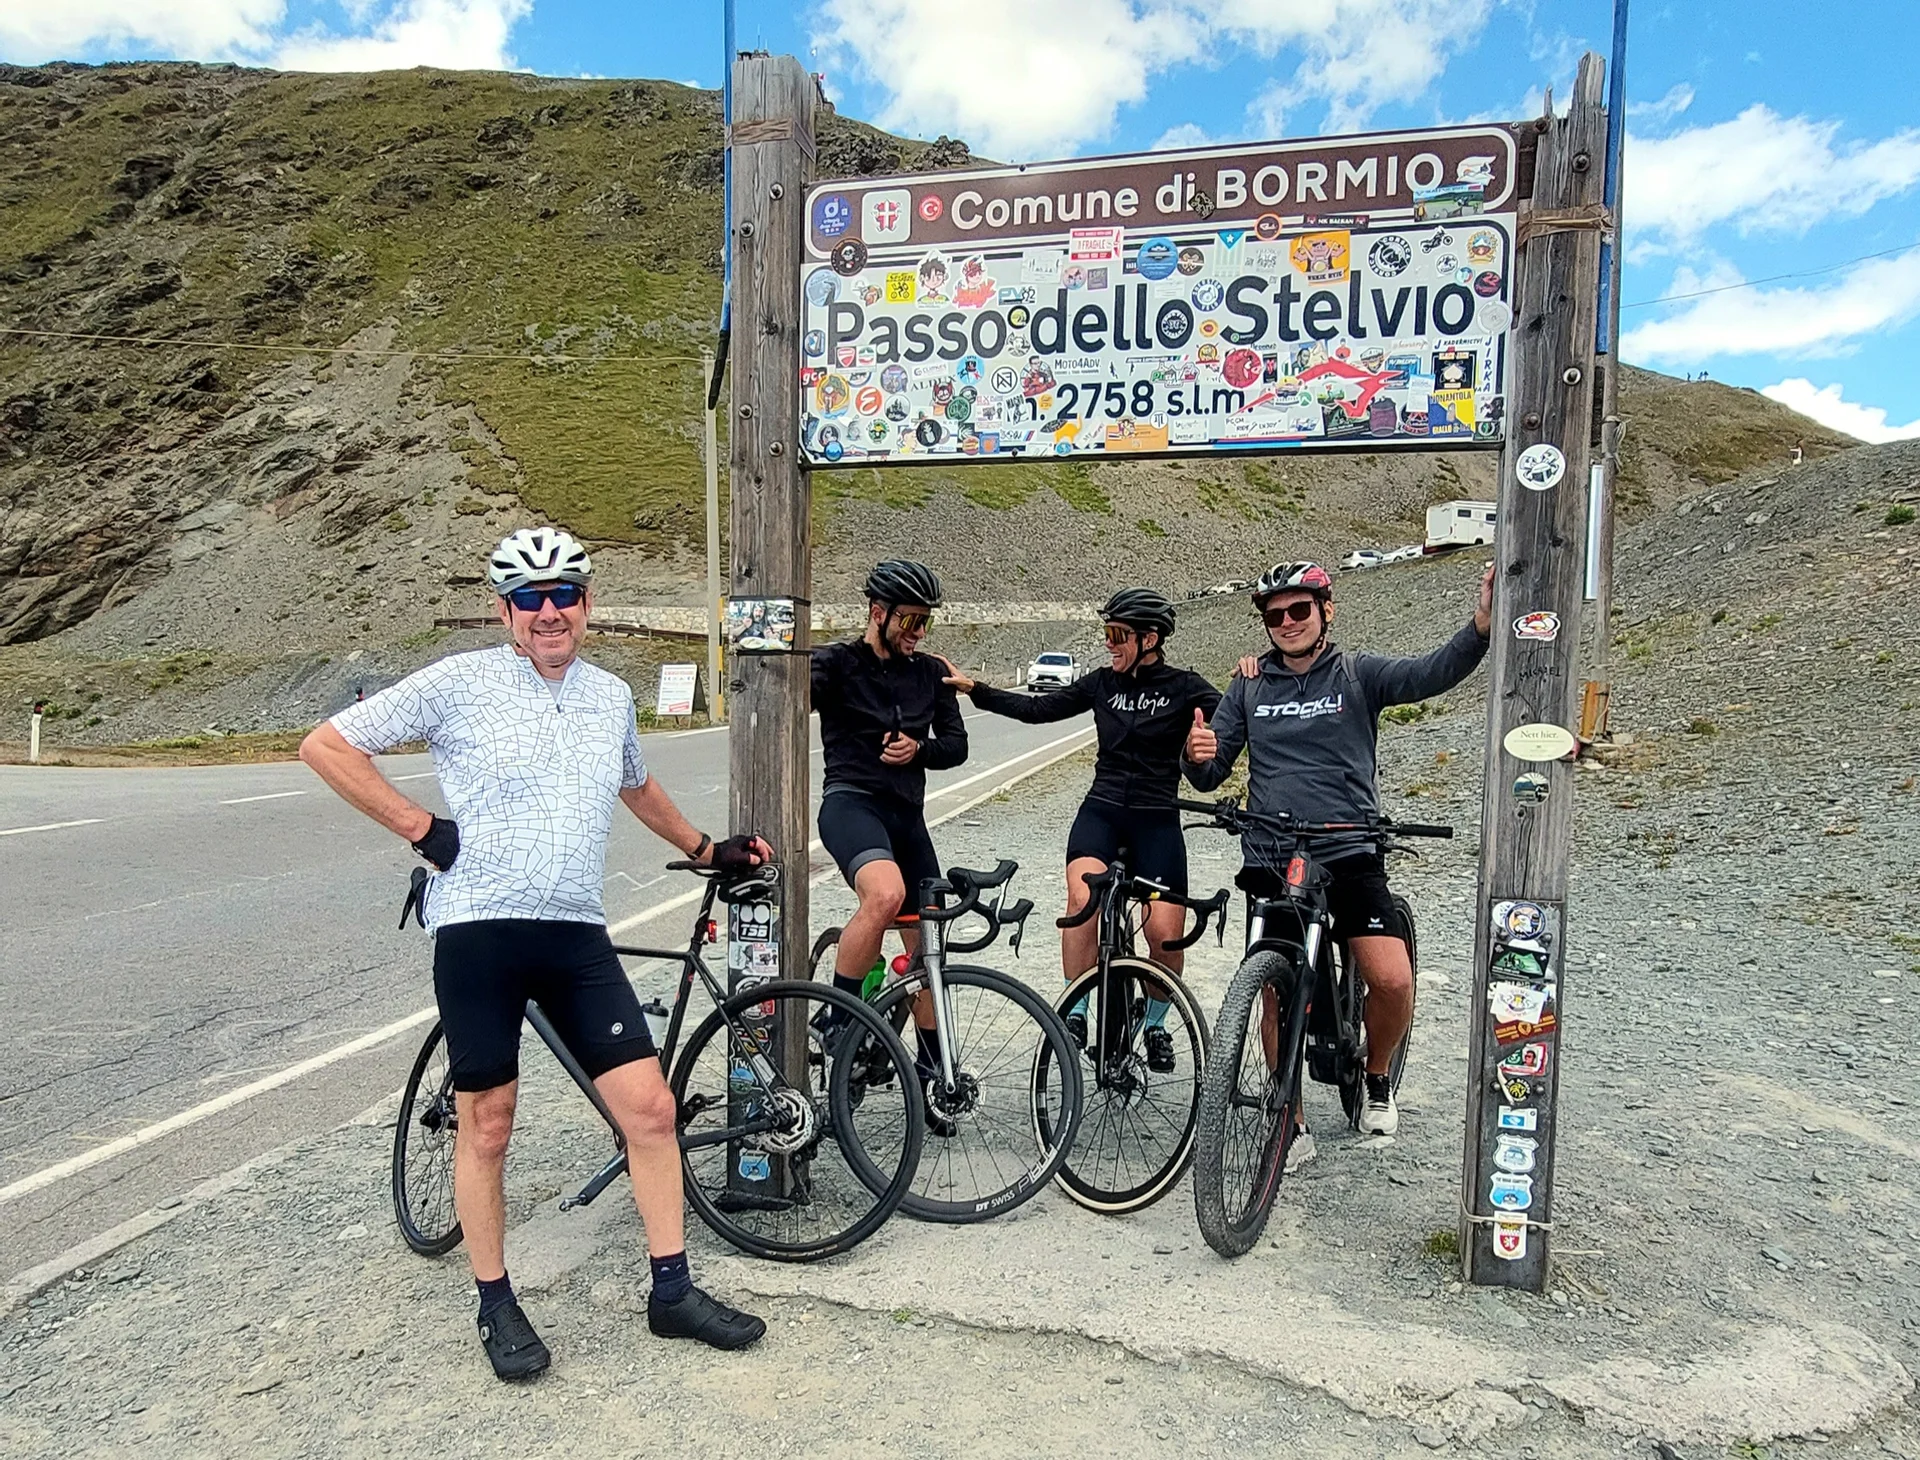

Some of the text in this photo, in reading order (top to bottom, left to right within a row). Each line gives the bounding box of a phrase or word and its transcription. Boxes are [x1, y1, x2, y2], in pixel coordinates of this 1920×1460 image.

[951, 187, 1139, 230] Comune
[1155, 172, 1196, 214] di
[1216, 153, 1444, 208] BORMIO
[1382, 235, 1411, 259] CORSICA
[828, 302, 1007, 365] Passo
[1030, 283, 1194, 355] dello
[1220, 269, 1475, 345] Stelvio
[802, 370, 826, 386] gcc
[1056, 380, 1154, 419] 2758
[1167, 383, 1253, 416] s.l.m.
[1431, 391, 1472, 403] NONANTOLA
[1107, 691, 1170, 716] Maloja
[1520, 730, 1559, 739] Nett hier.
[932, 922, 940, 951] BMC
[975, 1201, 990, 1213] DT
[991, 1189, 1016, 1208] SWISS
